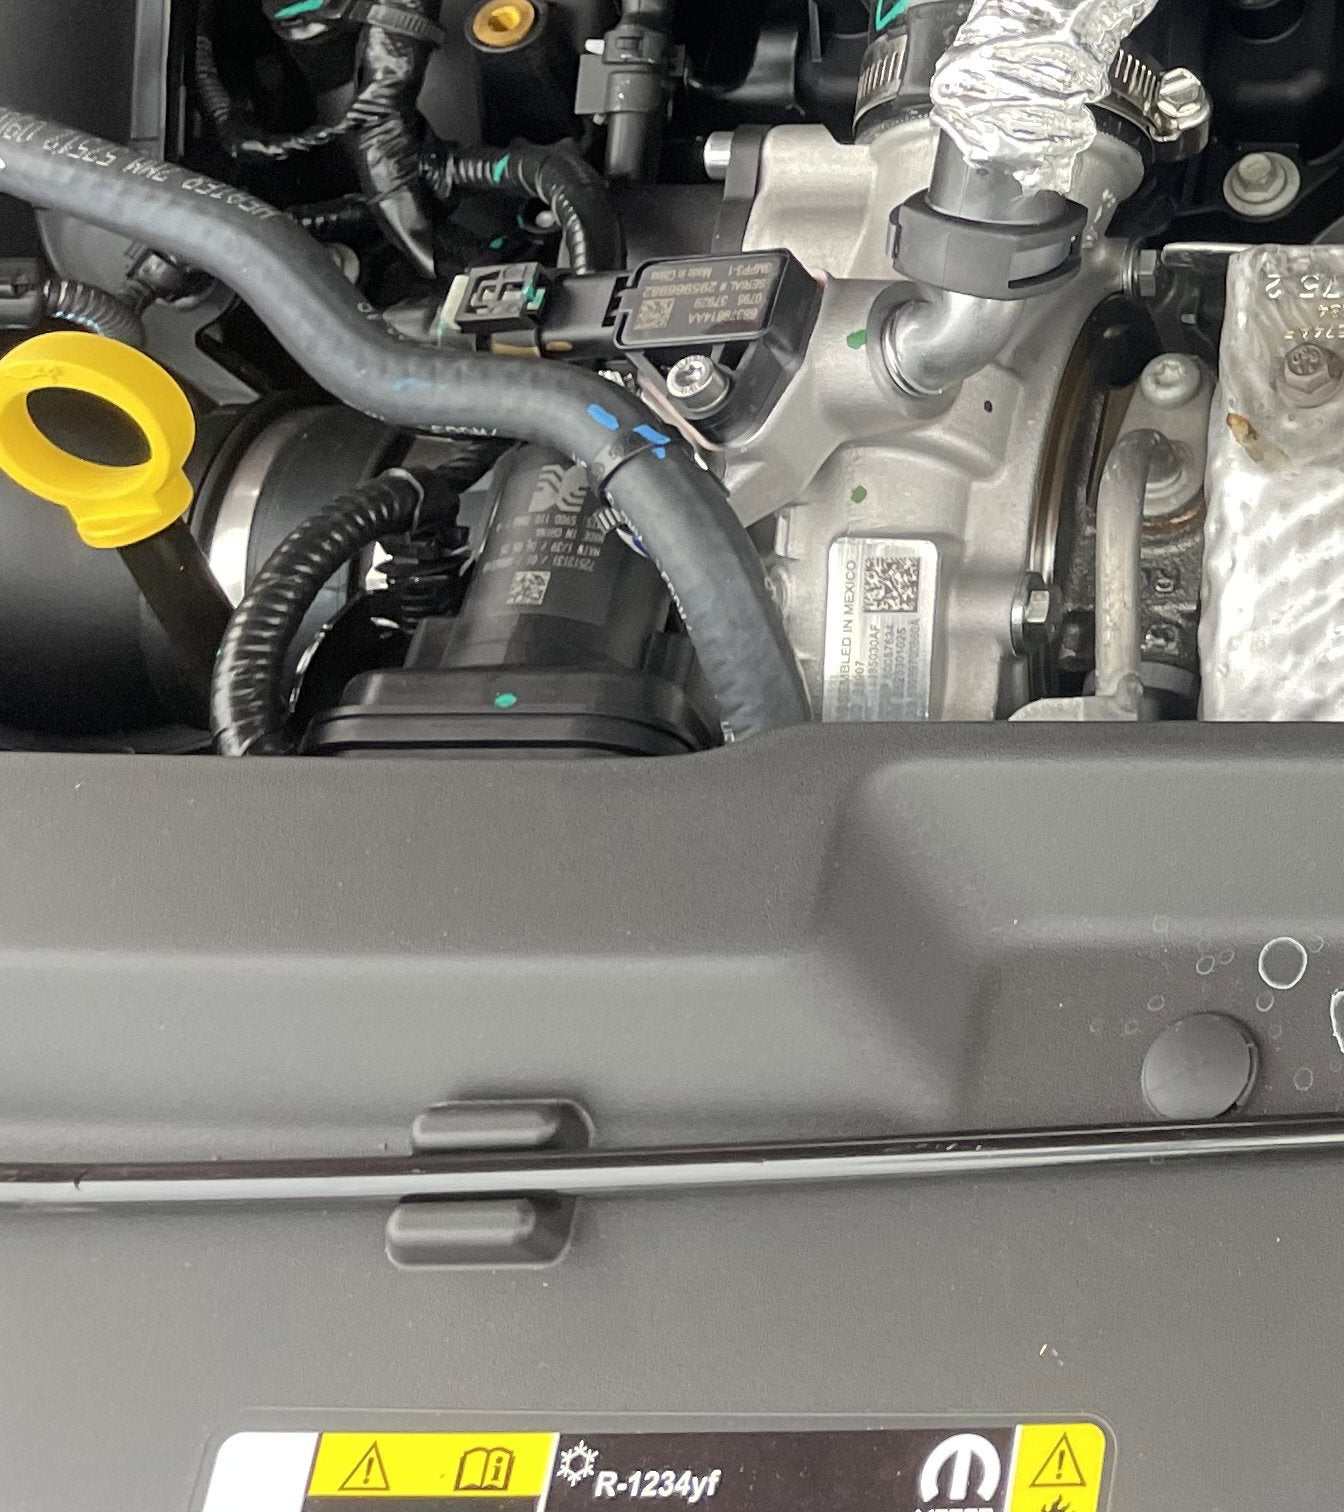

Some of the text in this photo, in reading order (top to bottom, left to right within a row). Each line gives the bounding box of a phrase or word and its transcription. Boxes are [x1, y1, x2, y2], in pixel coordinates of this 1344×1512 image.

[728, 278, 766, 290] SERIAL
[843, 559, 856, 615] MEXICO
[842, 619, 852, 632] IN
[595, 1469, 722, 1503] R-1234yf
